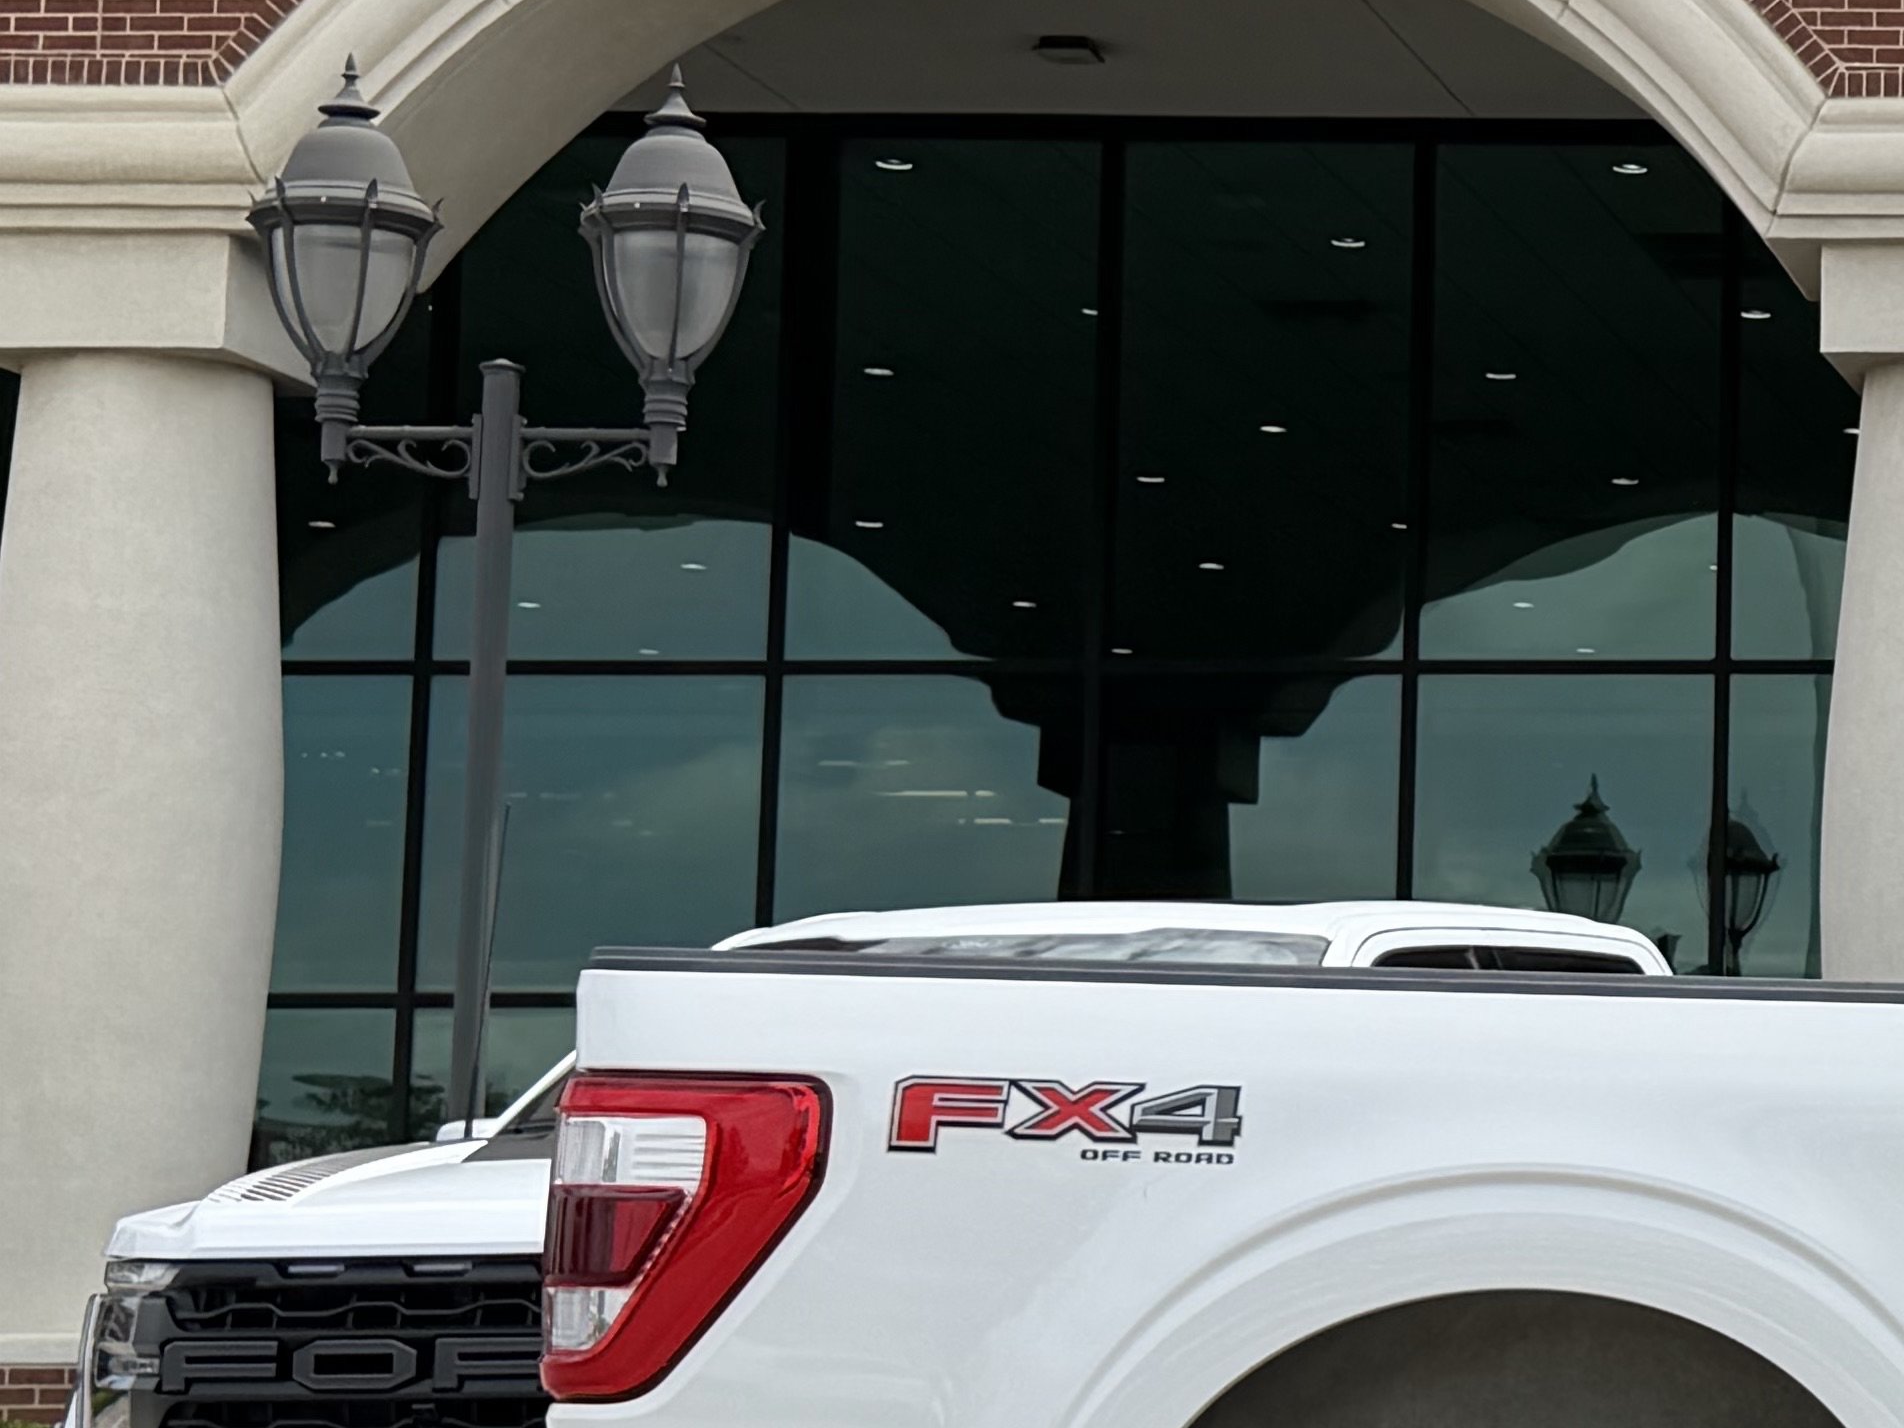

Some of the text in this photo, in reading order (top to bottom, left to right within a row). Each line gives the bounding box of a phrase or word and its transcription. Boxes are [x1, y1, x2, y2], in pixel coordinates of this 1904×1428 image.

[887, 1075, 1242, 1154] FX4
[1079, 1149, 1235, 1166] OFF ROAD
[161, 1339, 543, 1391] FOR
